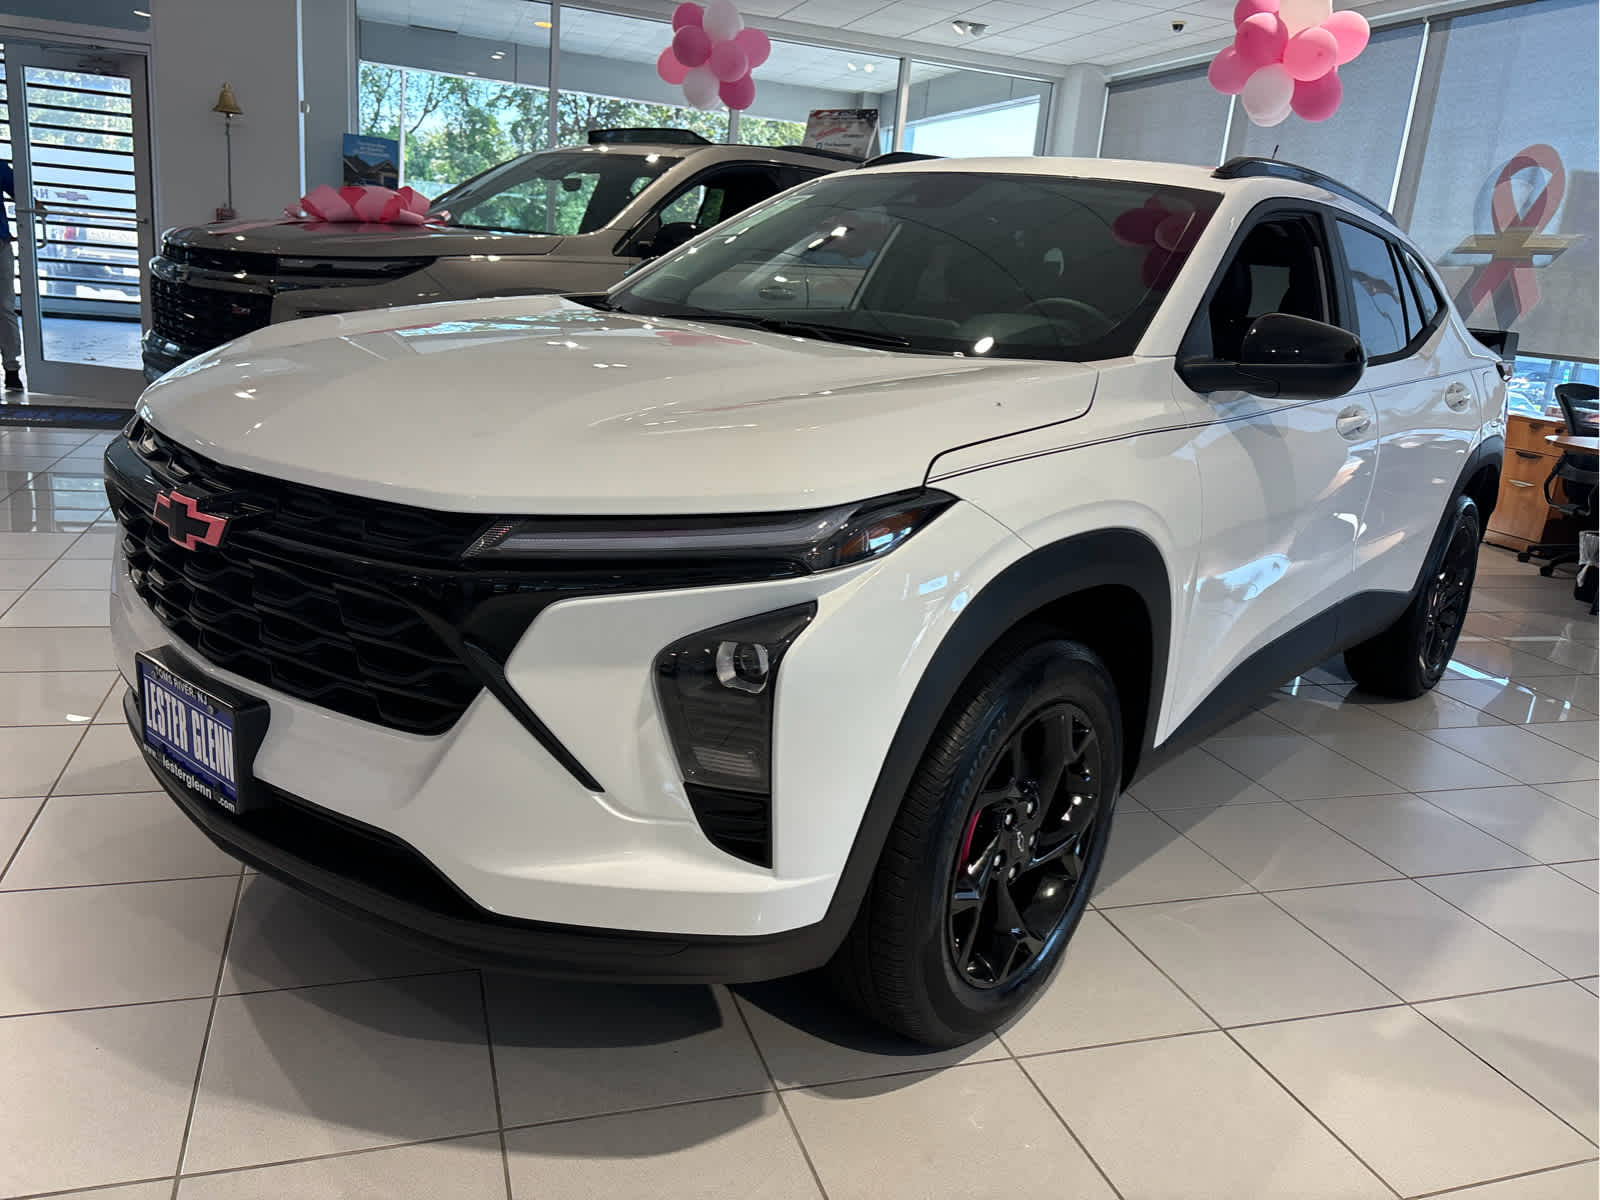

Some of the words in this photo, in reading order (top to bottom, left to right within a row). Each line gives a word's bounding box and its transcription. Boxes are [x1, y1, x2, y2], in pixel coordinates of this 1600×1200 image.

[143, 678, 189, 753] LESTER
[191, 708, 235, 784] GLENN
[162, 754, 212, 800] lesterglenn
